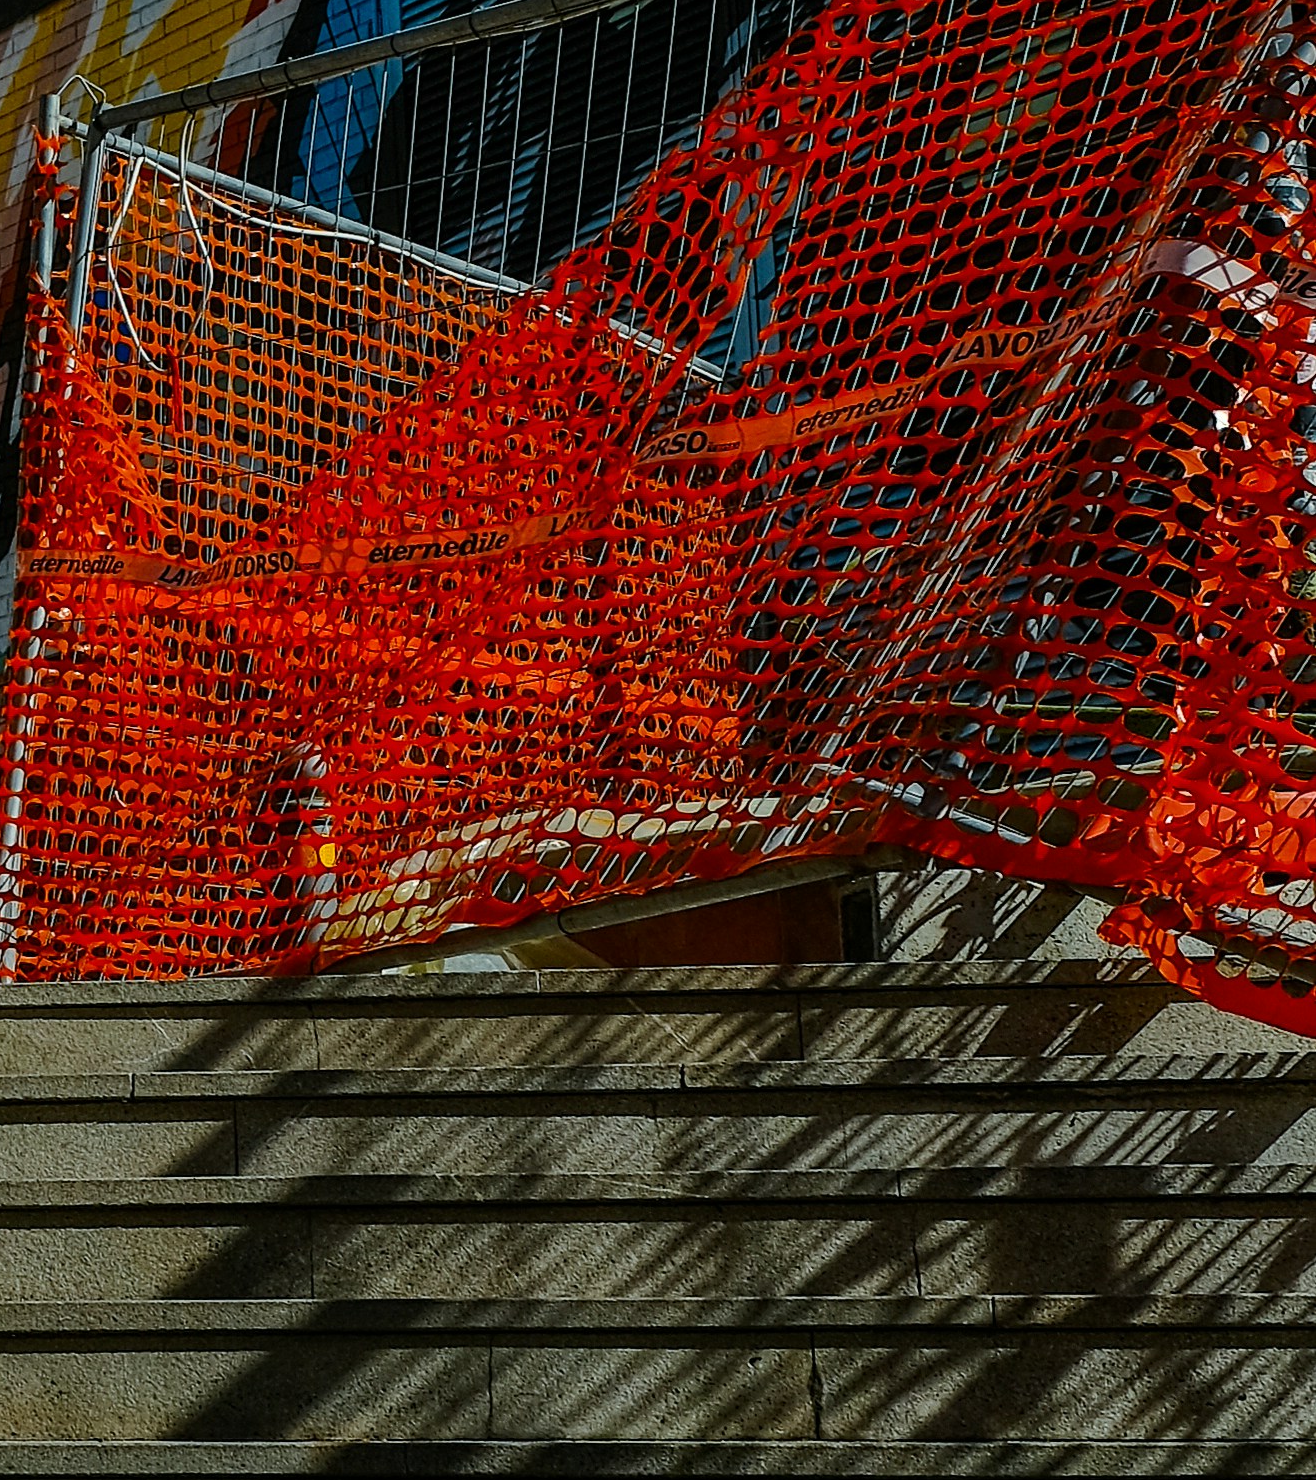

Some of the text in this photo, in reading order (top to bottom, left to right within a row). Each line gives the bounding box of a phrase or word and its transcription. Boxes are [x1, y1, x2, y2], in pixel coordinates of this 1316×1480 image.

[795, 382, 922, 437] eternedil
[369, 532, 509, 564] eternedile
[29, 555, 124, 574] eternedile
[233, 551, 293, 578] CORSO
